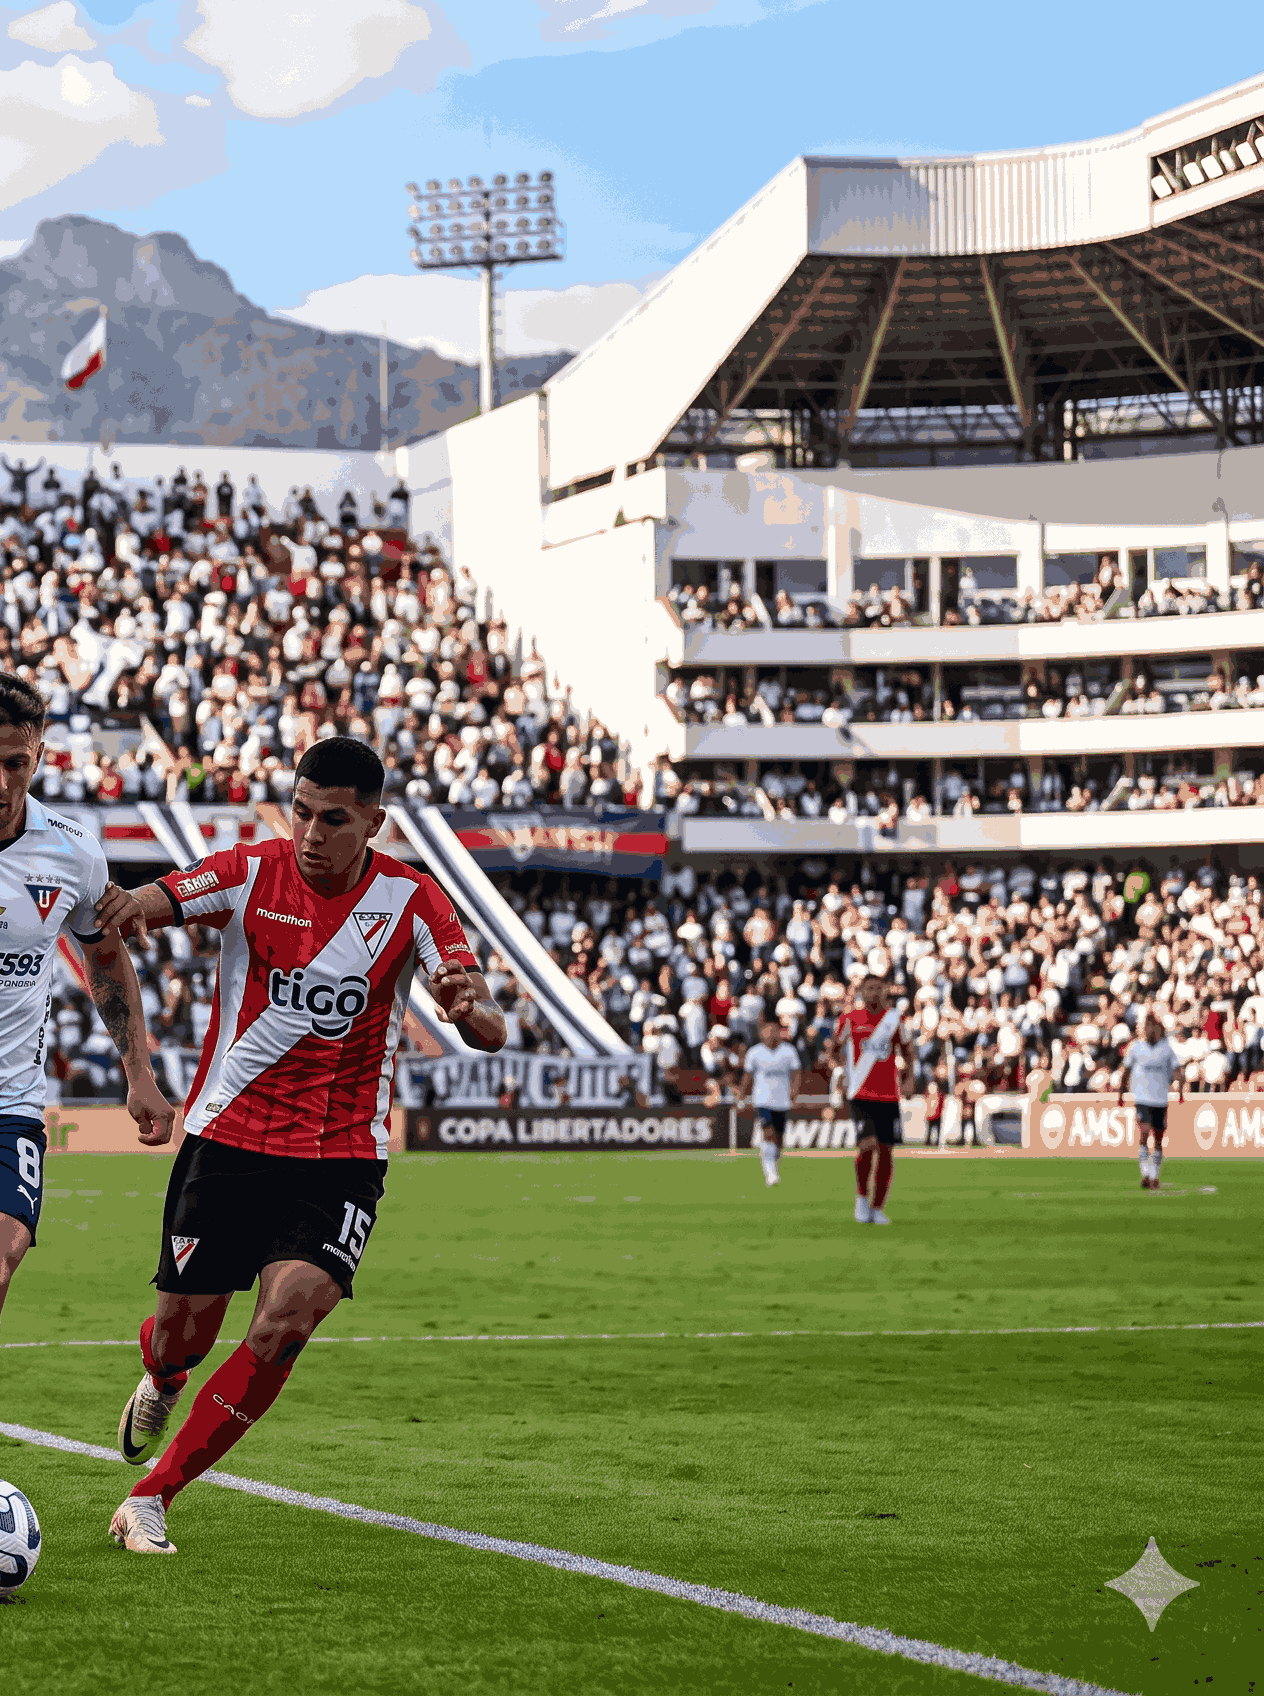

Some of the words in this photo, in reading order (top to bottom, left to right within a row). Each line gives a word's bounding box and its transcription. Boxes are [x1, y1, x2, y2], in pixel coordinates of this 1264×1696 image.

[256, 907, 312, 927] marathon
[438, 1117, 514, 1144] COPA
[1067, 1106, 1169, 1147] AMST
[1221, 1106, 1264, 1148] AM
[17, 1137, 40, 1189] 8
[338, 1201, 372, 1260] 15
